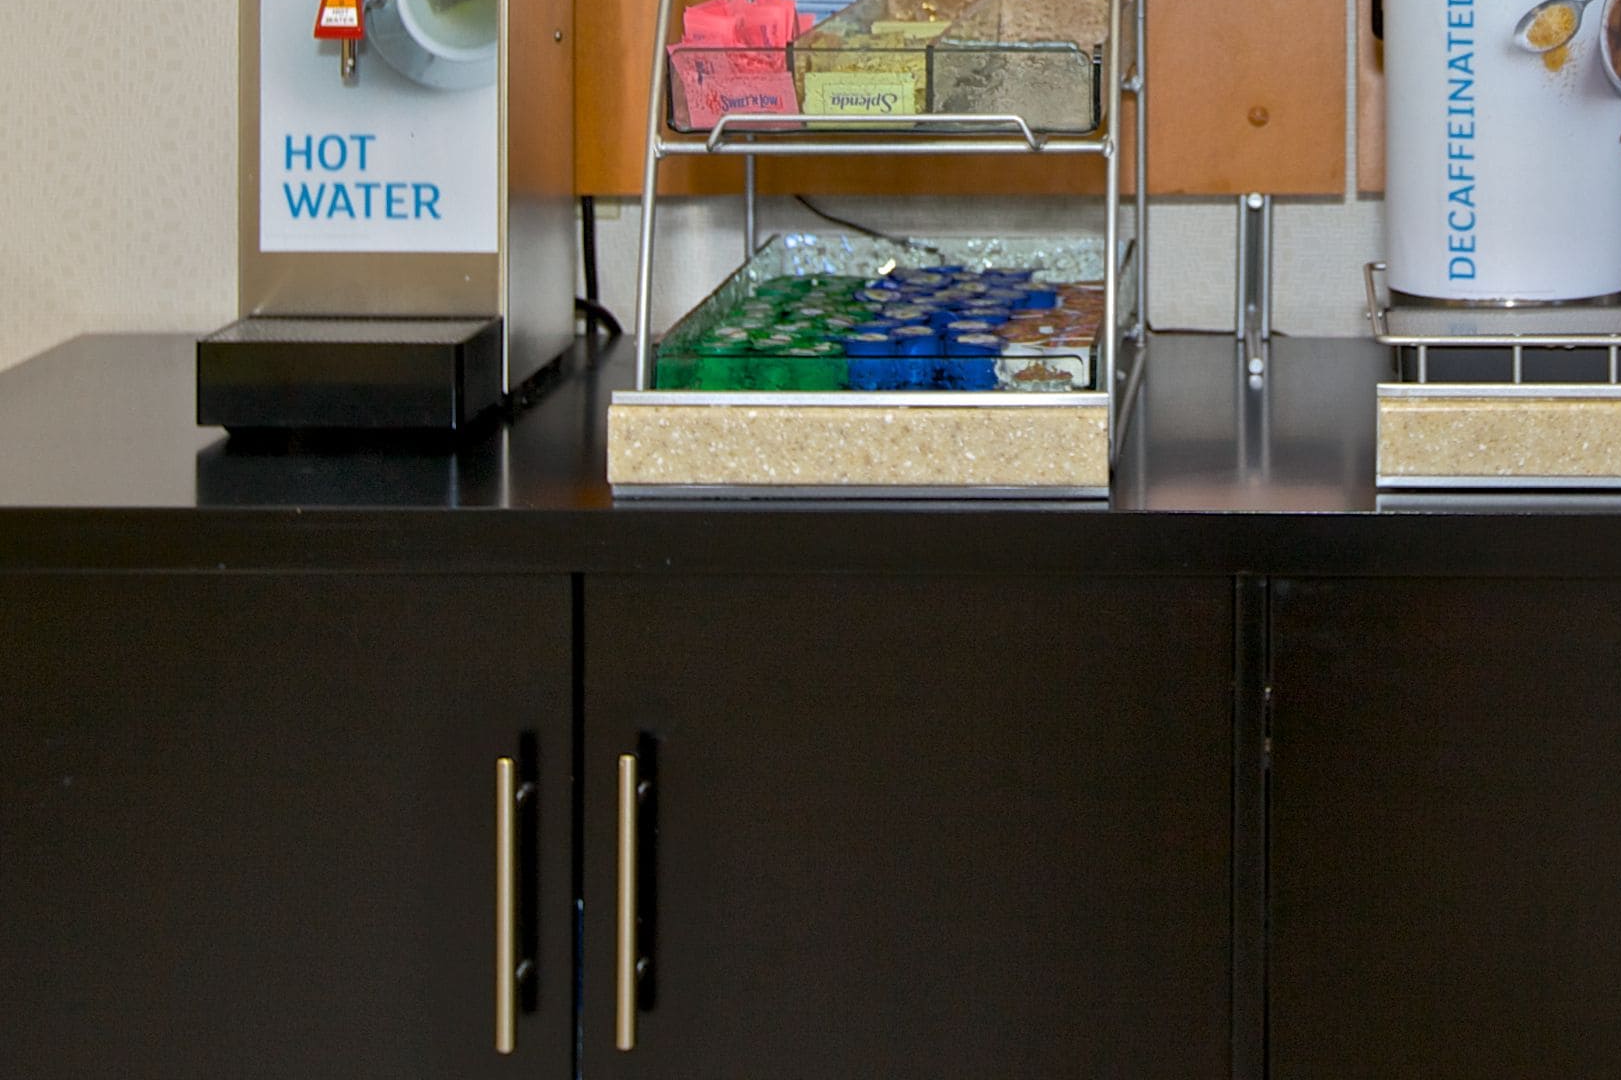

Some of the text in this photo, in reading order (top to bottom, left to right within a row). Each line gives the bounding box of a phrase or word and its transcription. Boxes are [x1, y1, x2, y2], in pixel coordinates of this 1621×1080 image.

[831, 92, 898, 114] Splenda
[284, 133, 376, 172] HOT
[282, 182, 441, 220] WATER
